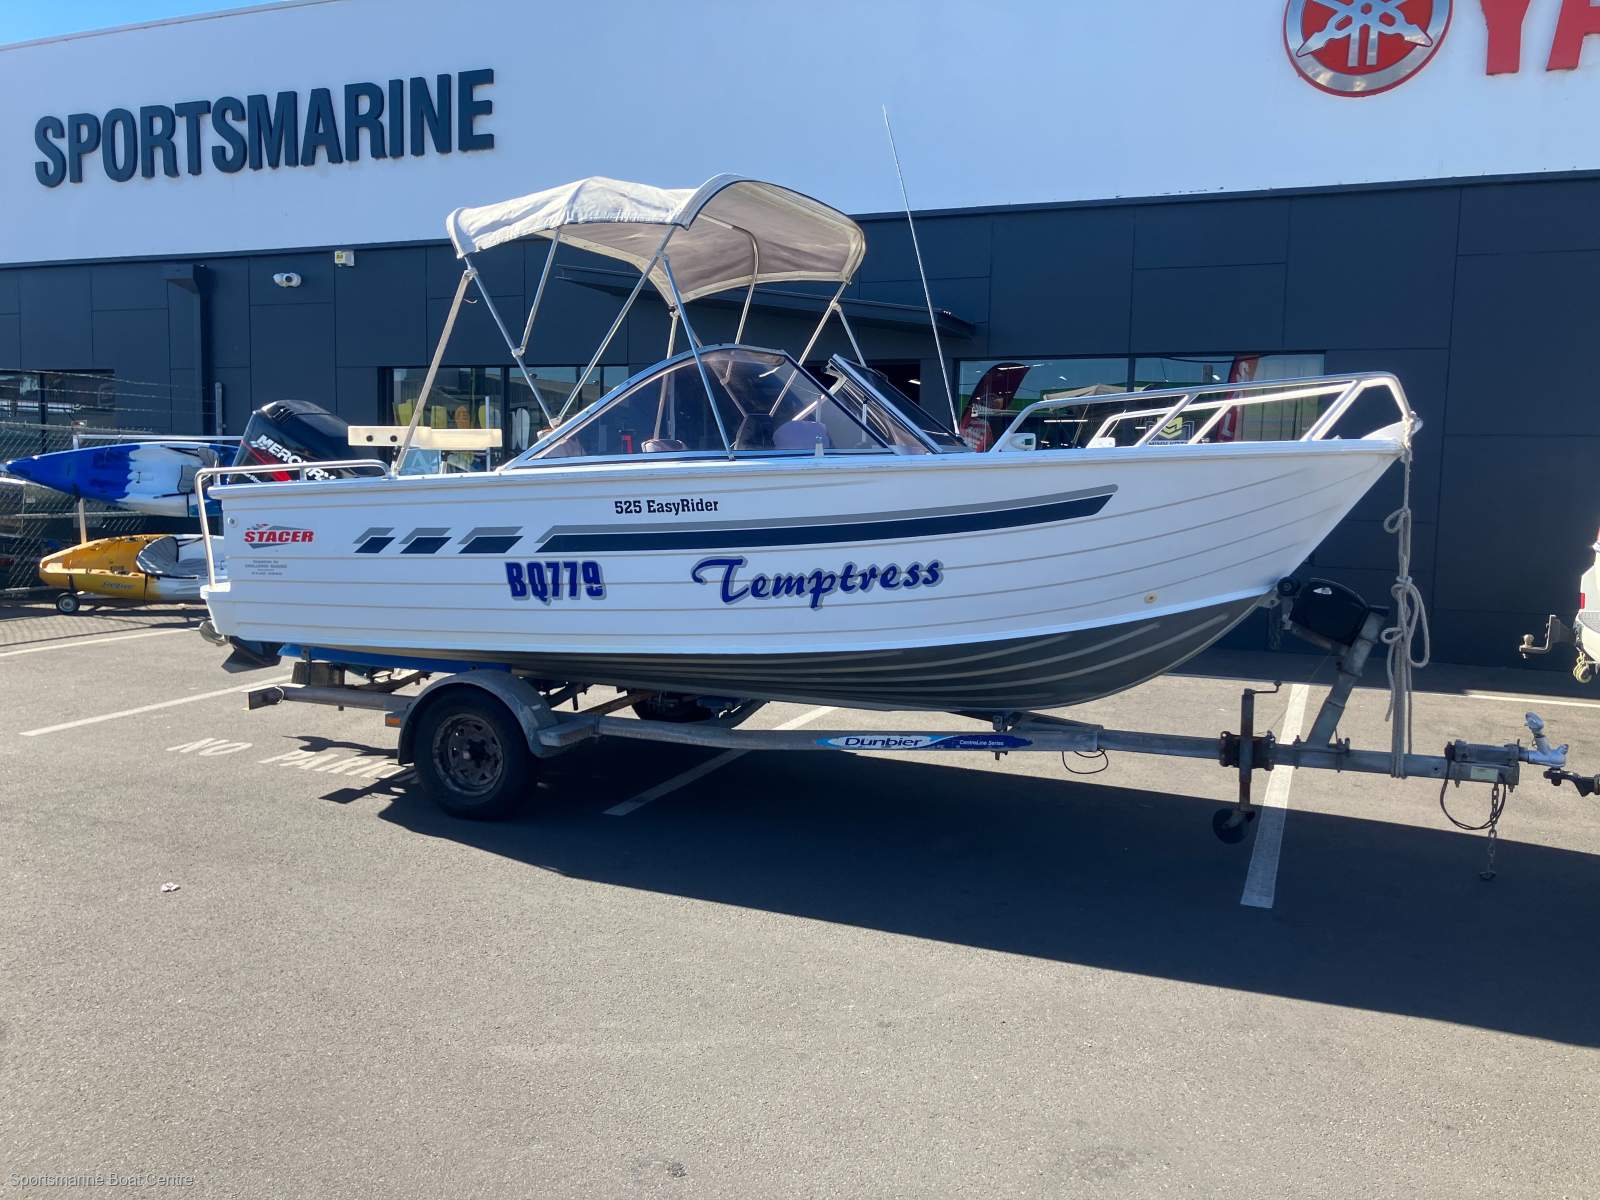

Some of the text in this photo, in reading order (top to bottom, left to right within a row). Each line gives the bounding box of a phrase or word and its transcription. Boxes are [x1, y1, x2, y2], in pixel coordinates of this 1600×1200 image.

[34, 68, 495, 188] SPORTSMARINE
[251, 434, 336, 481] MERCR
[614, 498, 719, 516] 525 EasyRider
[244, 530, 314, 543] STACER
[504, 560, 607, 606] BQ779
[692, 555, 944, 610] Temptress
[166, 737, 253, 757] NO
[844, 736, 923, 747] Dunbier
